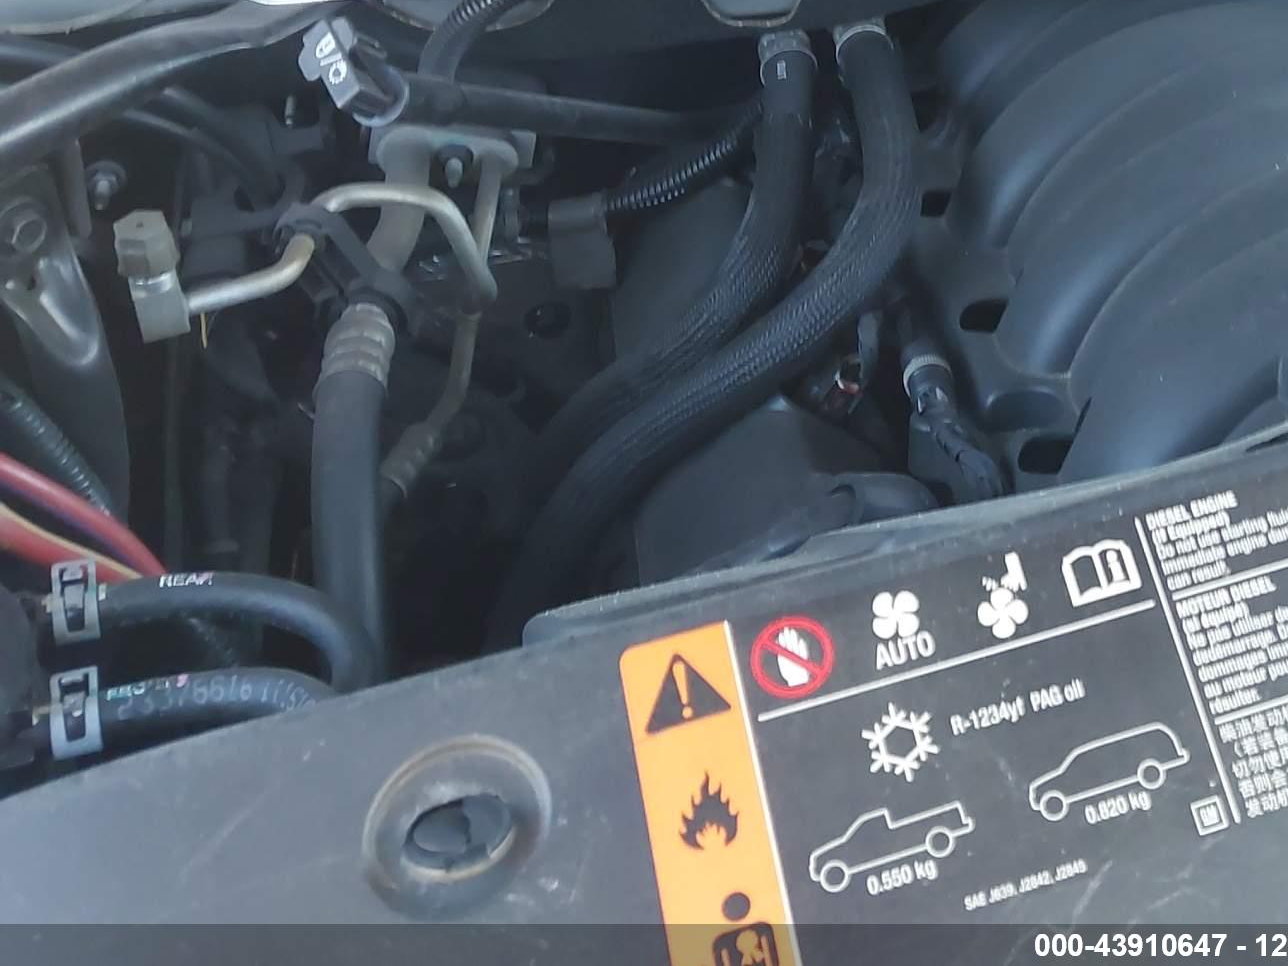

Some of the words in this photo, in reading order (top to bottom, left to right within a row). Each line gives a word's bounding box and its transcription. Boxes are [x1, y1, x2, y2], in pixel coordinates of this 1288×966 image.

[1145, 504, 1190, 530] DIESEL
[1190, 489, 1237, 517] ENGINE
[1155, 544, 1174, 560] Do
[1175, 536, 1196, 553] not
[1197, 531, 1219, 547] use
[1221, 516, 1267, 540] starting
[1160, 545, 1225, 575] Immediate
[1226, 534, 1266, 556] engine
[1166, 572, 1190, 590] can
[1175, 588, 1230, 618] MOTEUR
[1230, 576, 1276, 602] DIESEL
[876, 632, 936, 670] AUTO
[1207, 625, 1230, 647] pas
[1203, 681, 1221, 698] au
[1222, 668, 1266, 691] moteur
[951, 694, 1025, 736] R-1234yf
[1030, 687, 1062, 713] PAG
[1127, 790, 1152, 817] kg
[915, 858, 938, 883] kg
[964, 890, 988, 911] SAE
